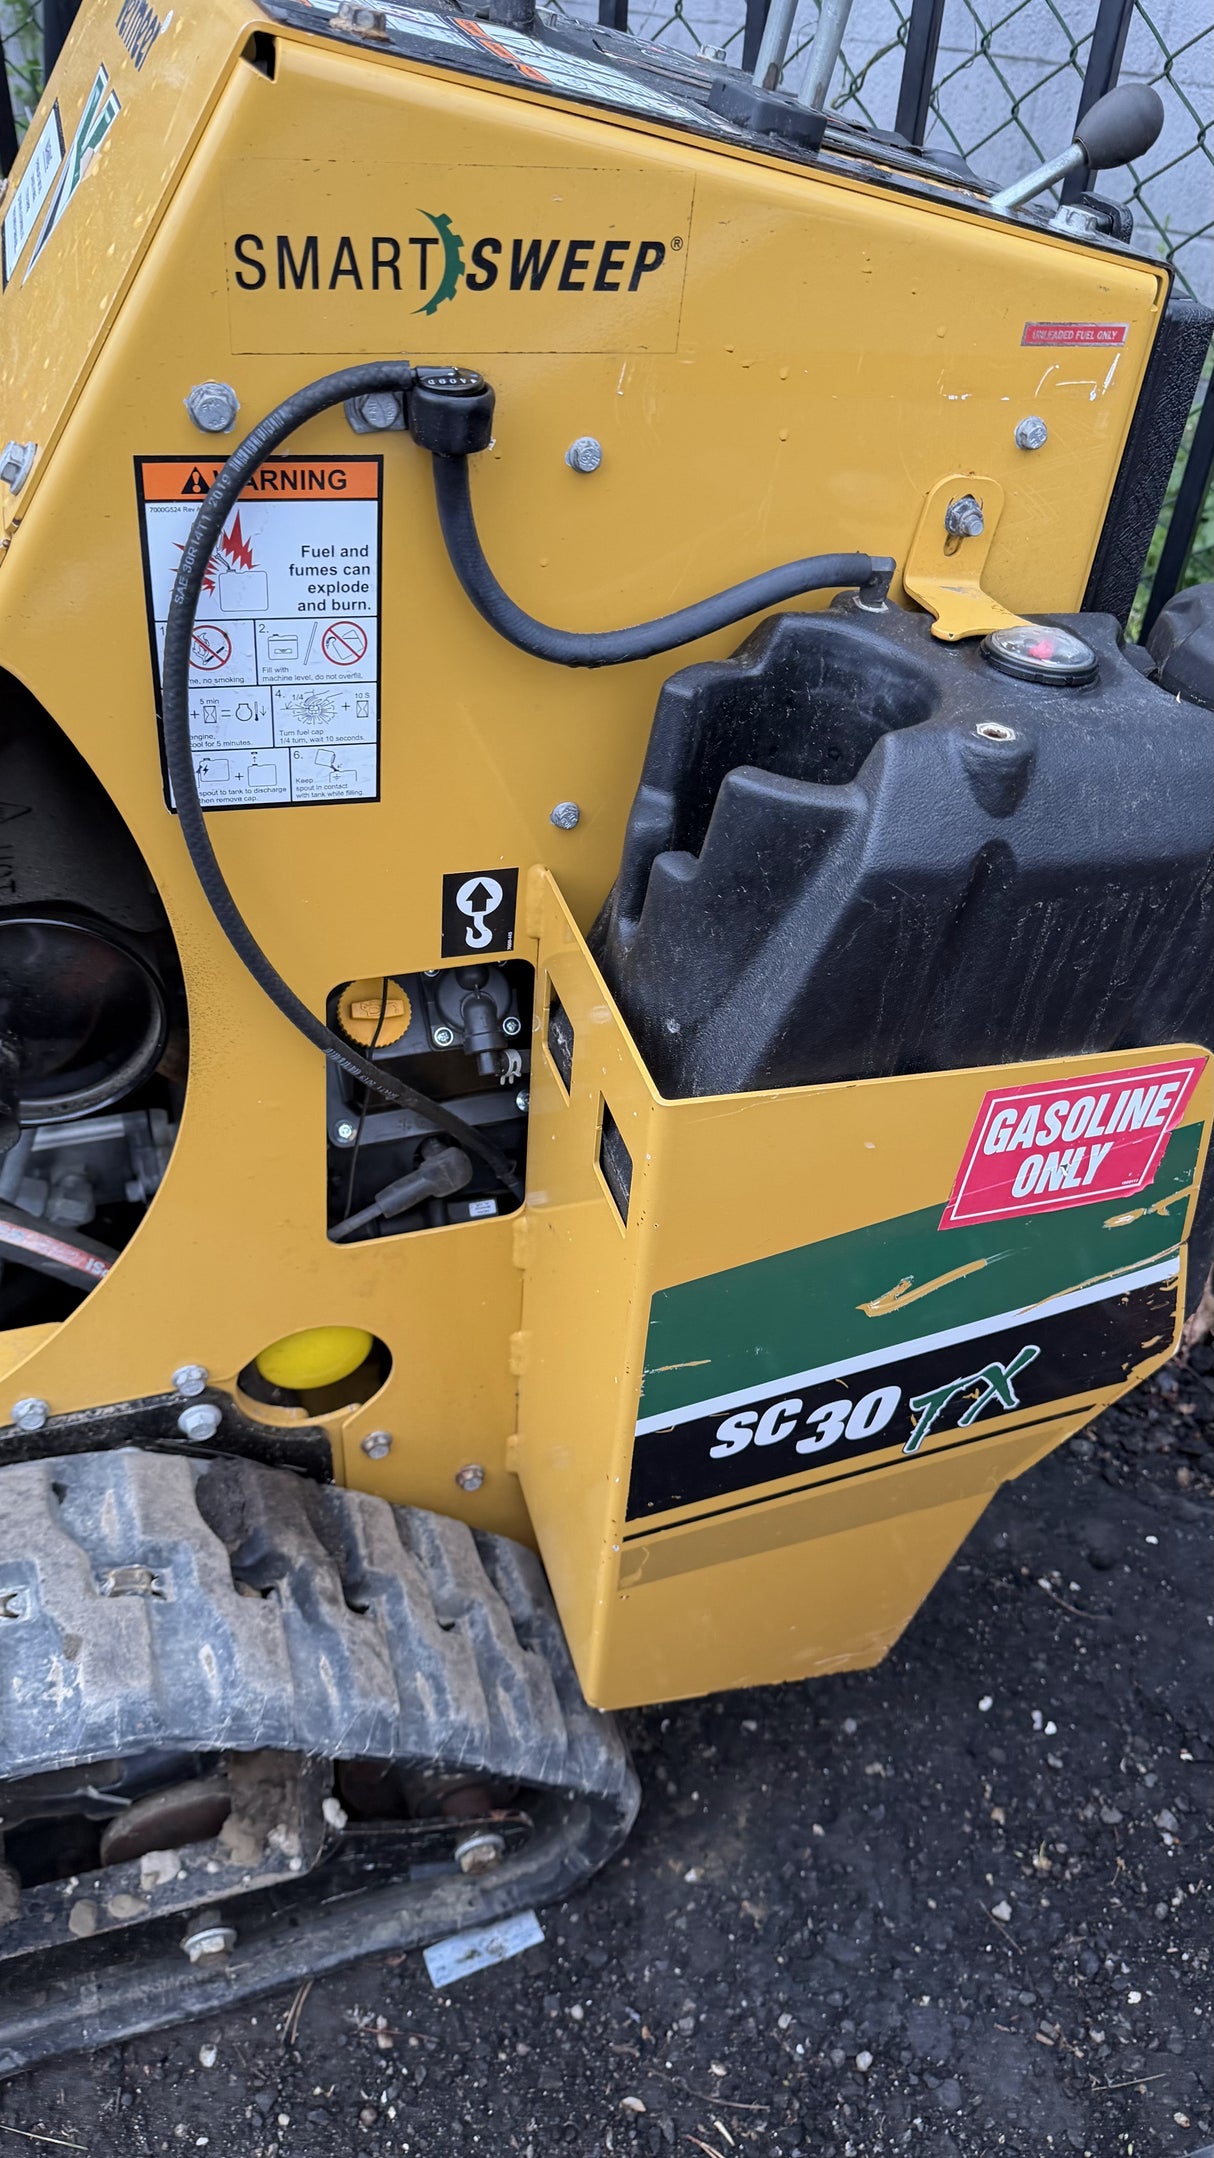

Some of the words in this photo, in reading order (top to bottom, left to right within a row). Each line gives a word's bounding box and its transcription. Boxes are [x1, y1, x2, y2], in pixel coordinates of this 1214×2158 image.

[234, 233, 440, 292] SMART
[1032, 329, 1075, 340] UNLEADED
[1075, 329, 1095, 340] FUEL
[1096, 329, 1118, 340] ONLY
[212, 468, 347, 491] ARNING
[183, 506, 196, 514] Rev
[173, 573, 191, 604] SAE
[208, 472, 232, 507] 2019
[301, 544, 335, 558] Fuel
[340, 544, 369, 558] and
[289, 563, 338, 576] fumes
[343, 564, 371, 576] can
[307, 580, 370, 597] explode
[297, 598, 326, 612] and
[331, 598, 371, 611] burn.
[258, 623, 270, 634] 2.
[262, 666, 273, 674] Fill
[262, 673, 293, 682] machine
[314, 673, 324, 681] do
[275, 689, 286, 699] 4.
[292, 693, 304, 701] 1/4
[205, 697, 220, 705] min
[279, 729, 295, 737] Turn
[311, 729, 324, 737] cap
[204, 740, 215, 748] for
[309, 735, 325, 743] wait
[326, 735, 334, 743] 10
[293, 750, 304, 760] 6.
[295, 777, 314, 786] Keep
[199, 789, 219, 798] spout
[219, 789, 227, 797] to
[228, 788, 243, 796] tank
[253, 786, 287, 795] discharge
[295, 784, 315, 793] spout
[323, 783, 348, 791] contact
[216, 796, 243, 804] remove
[295, 792, 311, 800] with
[311, 791, 326, 799] tank
[326, 790, 345, 798] while
[982, 1081, 1180, 1156] GASOLINE
[1010, 1141, 1114, 1199] ONLY
